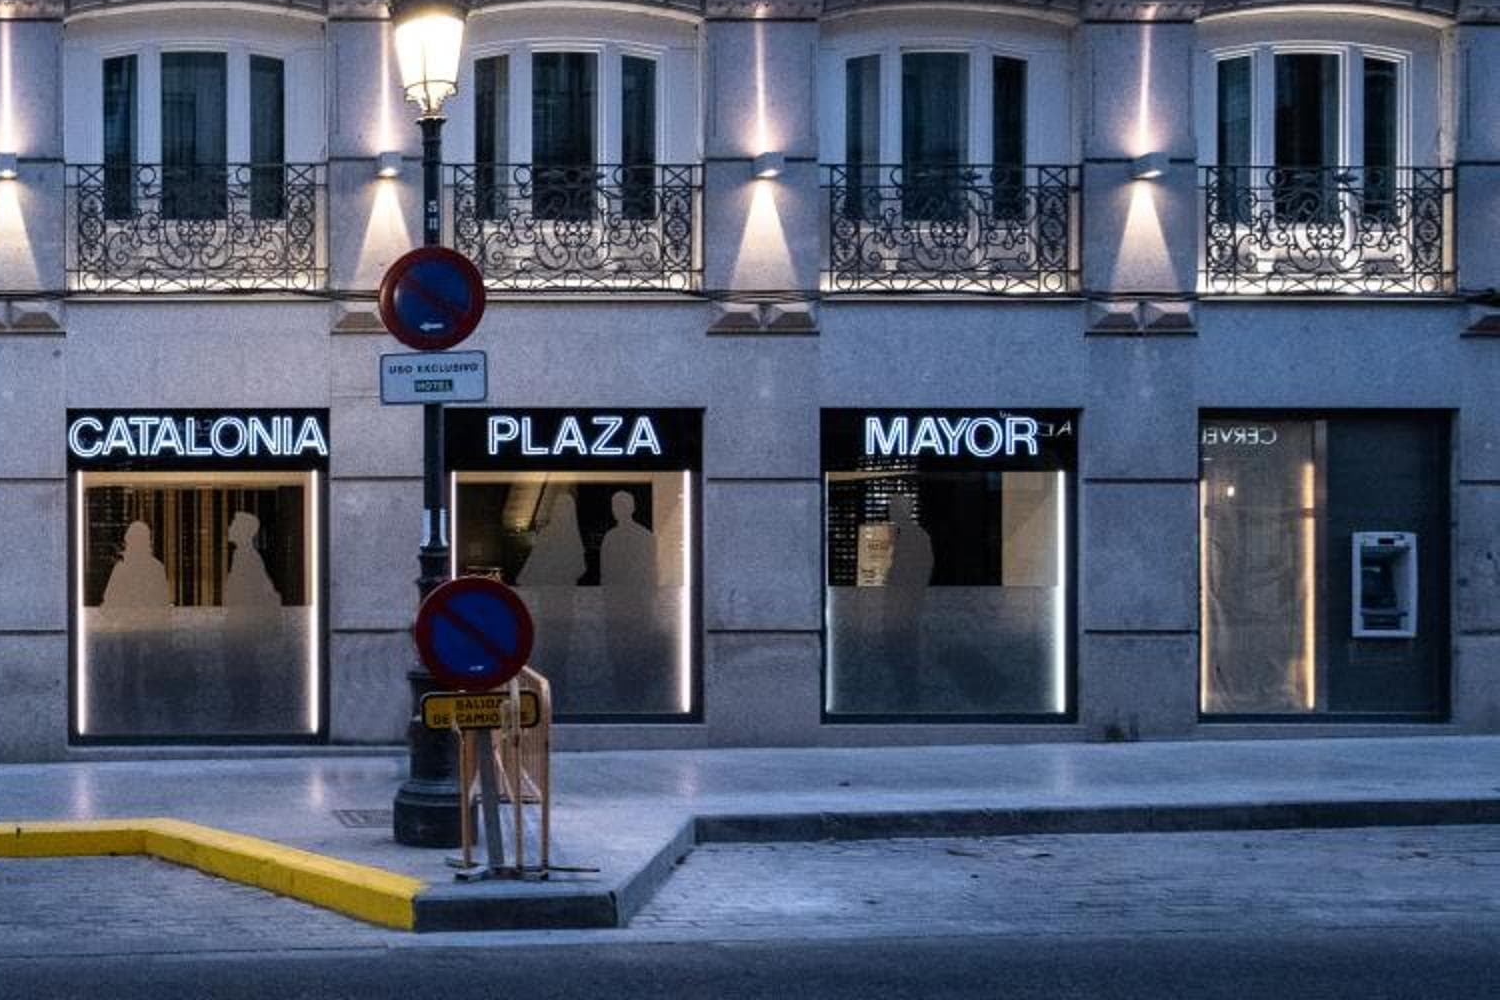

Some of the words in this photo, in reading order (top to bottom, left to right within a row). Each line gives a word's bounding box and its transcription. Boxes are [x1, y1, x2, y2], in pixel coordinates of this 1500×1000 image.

[389, 365, 413, 375] USO
[416, 362, 479, 374] EXCLUSIVO
[67, 416, 329, 458] CATALONIA
[487, 416, 662, 456] PLAZA
[865, 416, 1038, 457] MAYOR
[432, 713, 451, 726] DE
